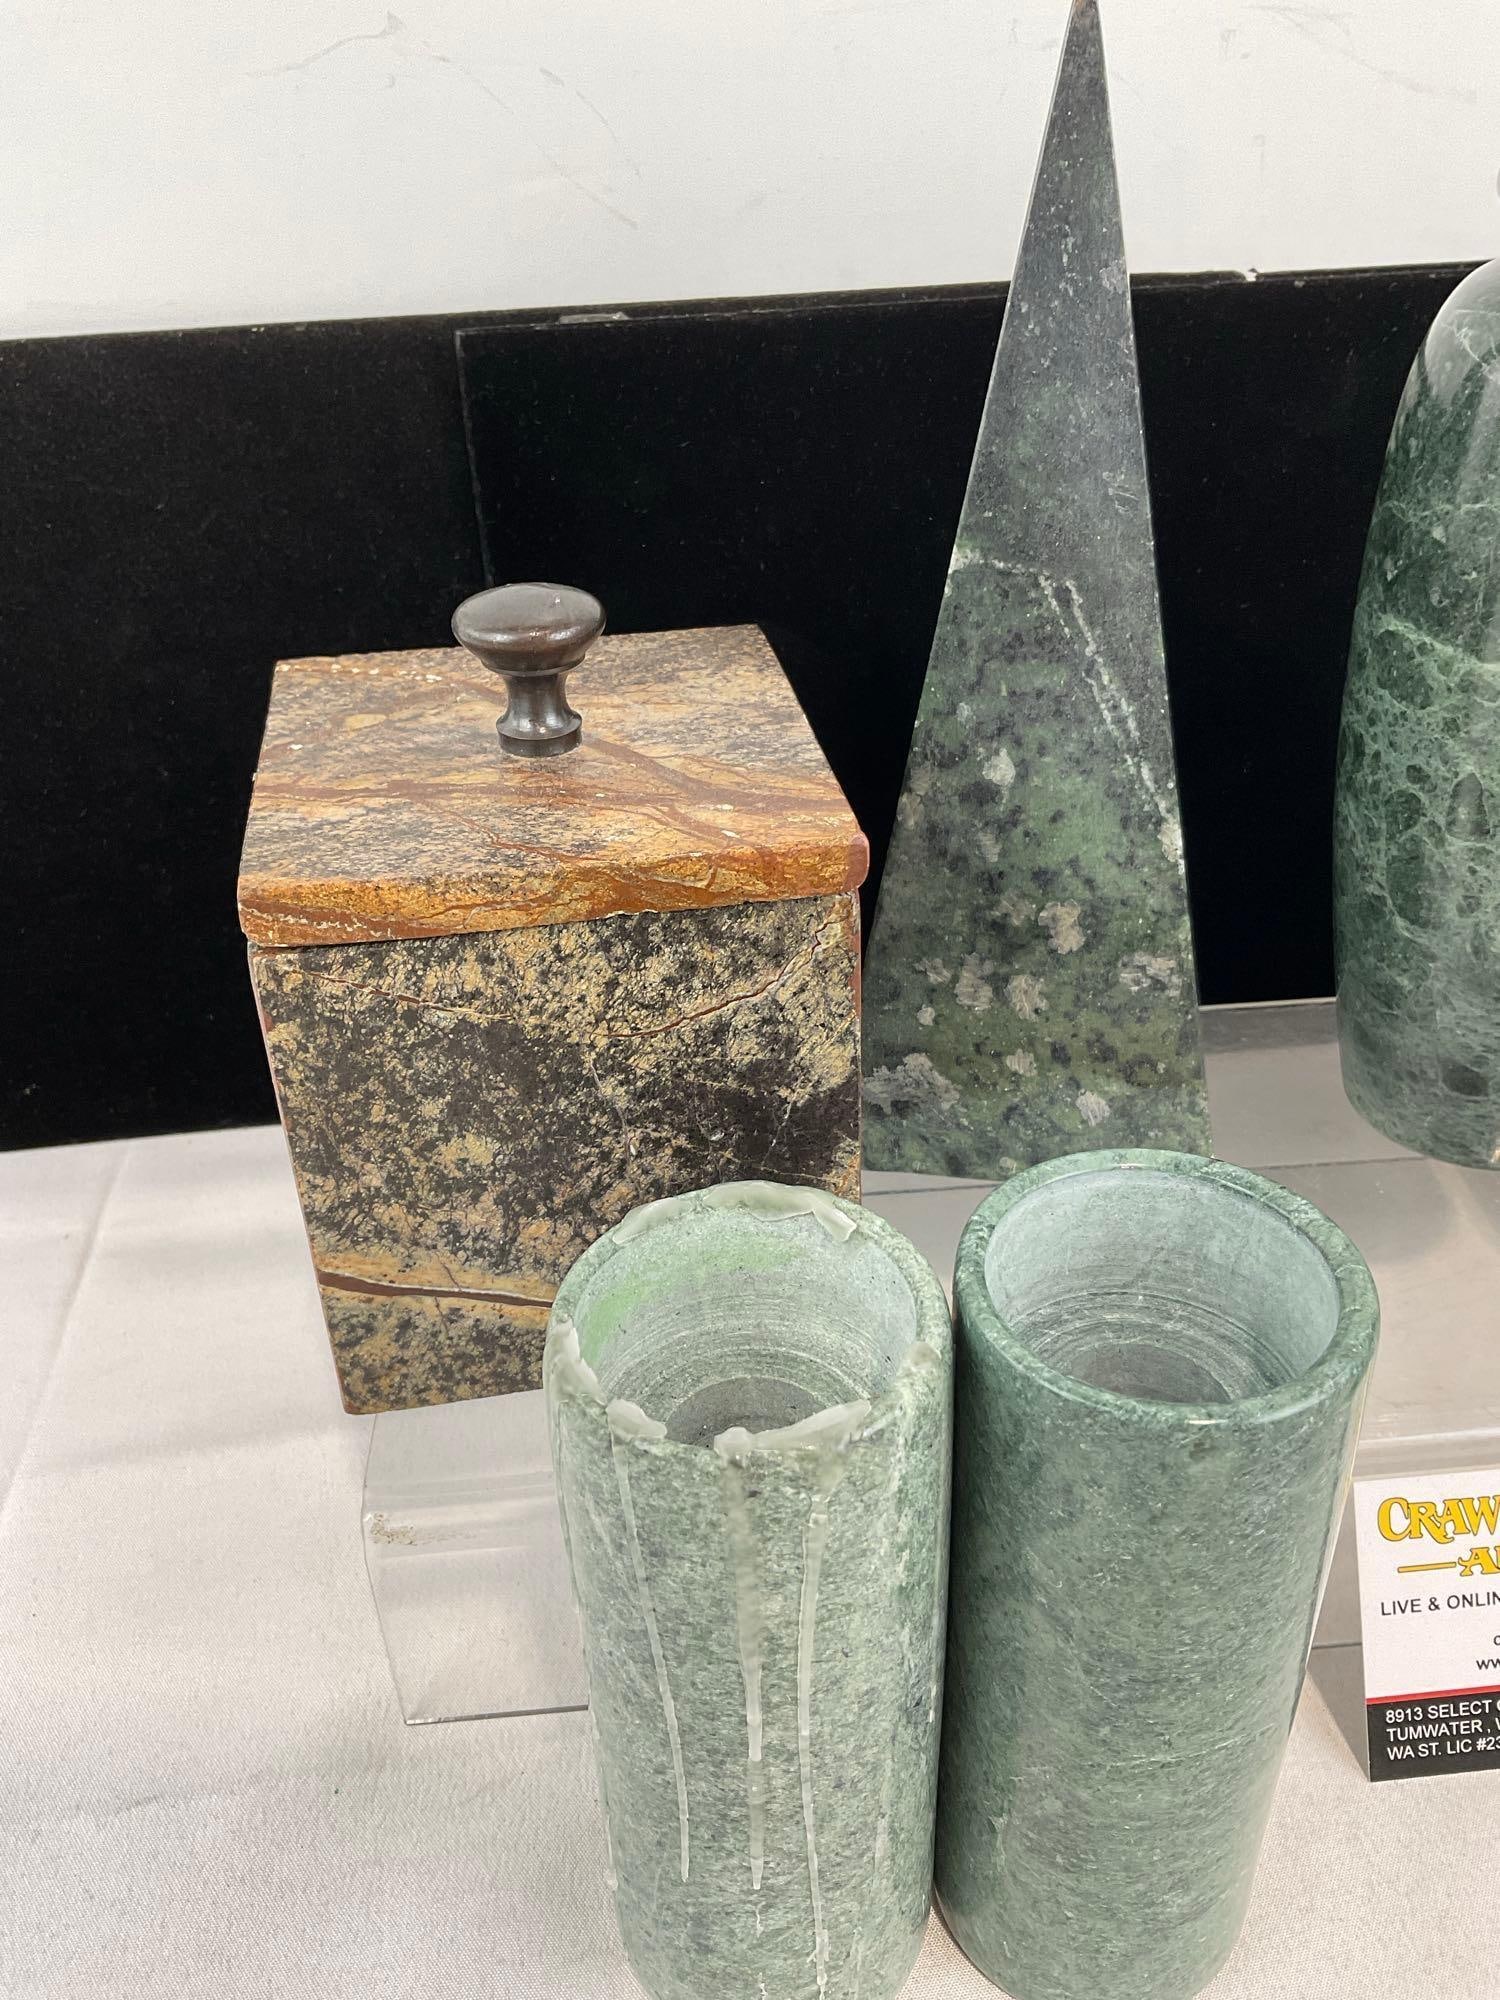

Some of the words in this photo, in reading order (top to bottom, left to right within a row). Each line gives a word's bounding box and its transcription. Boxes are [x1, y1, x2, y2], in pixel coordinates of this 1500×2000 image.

[1377, 1495, 1500, 1544] CRAW
[1458, 1545, 1500, 1577] A
[1381, 1599, 1422, 1616] LIVE
[1428, 1597, 1440, 1611] &
[1385, 1706, 1423, 1724] 8913
[1427, 1699, 1492, 1720] SELECT
[1386, 1719, 1483, 1742] TUMWATER
[1387, 1745, 1415, 1761] WA
[1418, 1742, 1442, 1757] ST.
[1446, 1739, 1472, 1755] LIC
